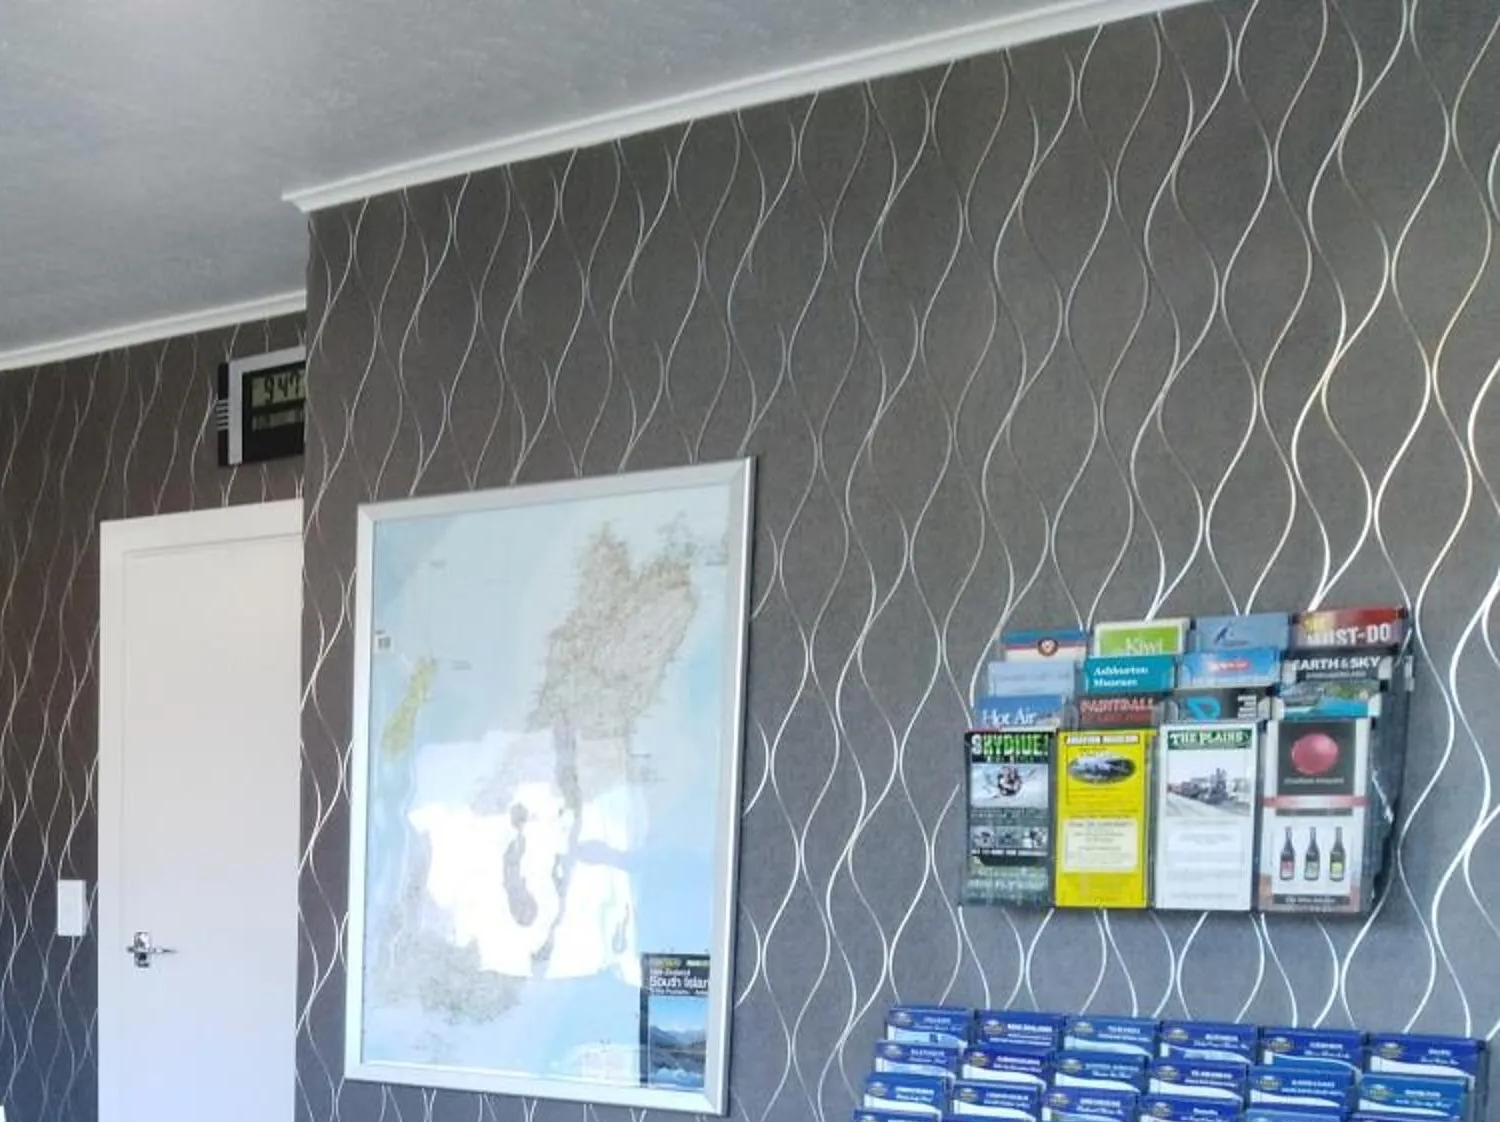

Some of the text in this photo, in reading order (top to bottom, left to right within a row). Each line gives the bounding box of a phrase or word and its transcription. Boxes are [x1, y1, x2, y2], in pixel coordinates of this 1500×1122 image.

[1350, 657, 1380, 669] SKY
[1013, 708, 1037, 725] Air
[684, 976, 709, 988] Islan
